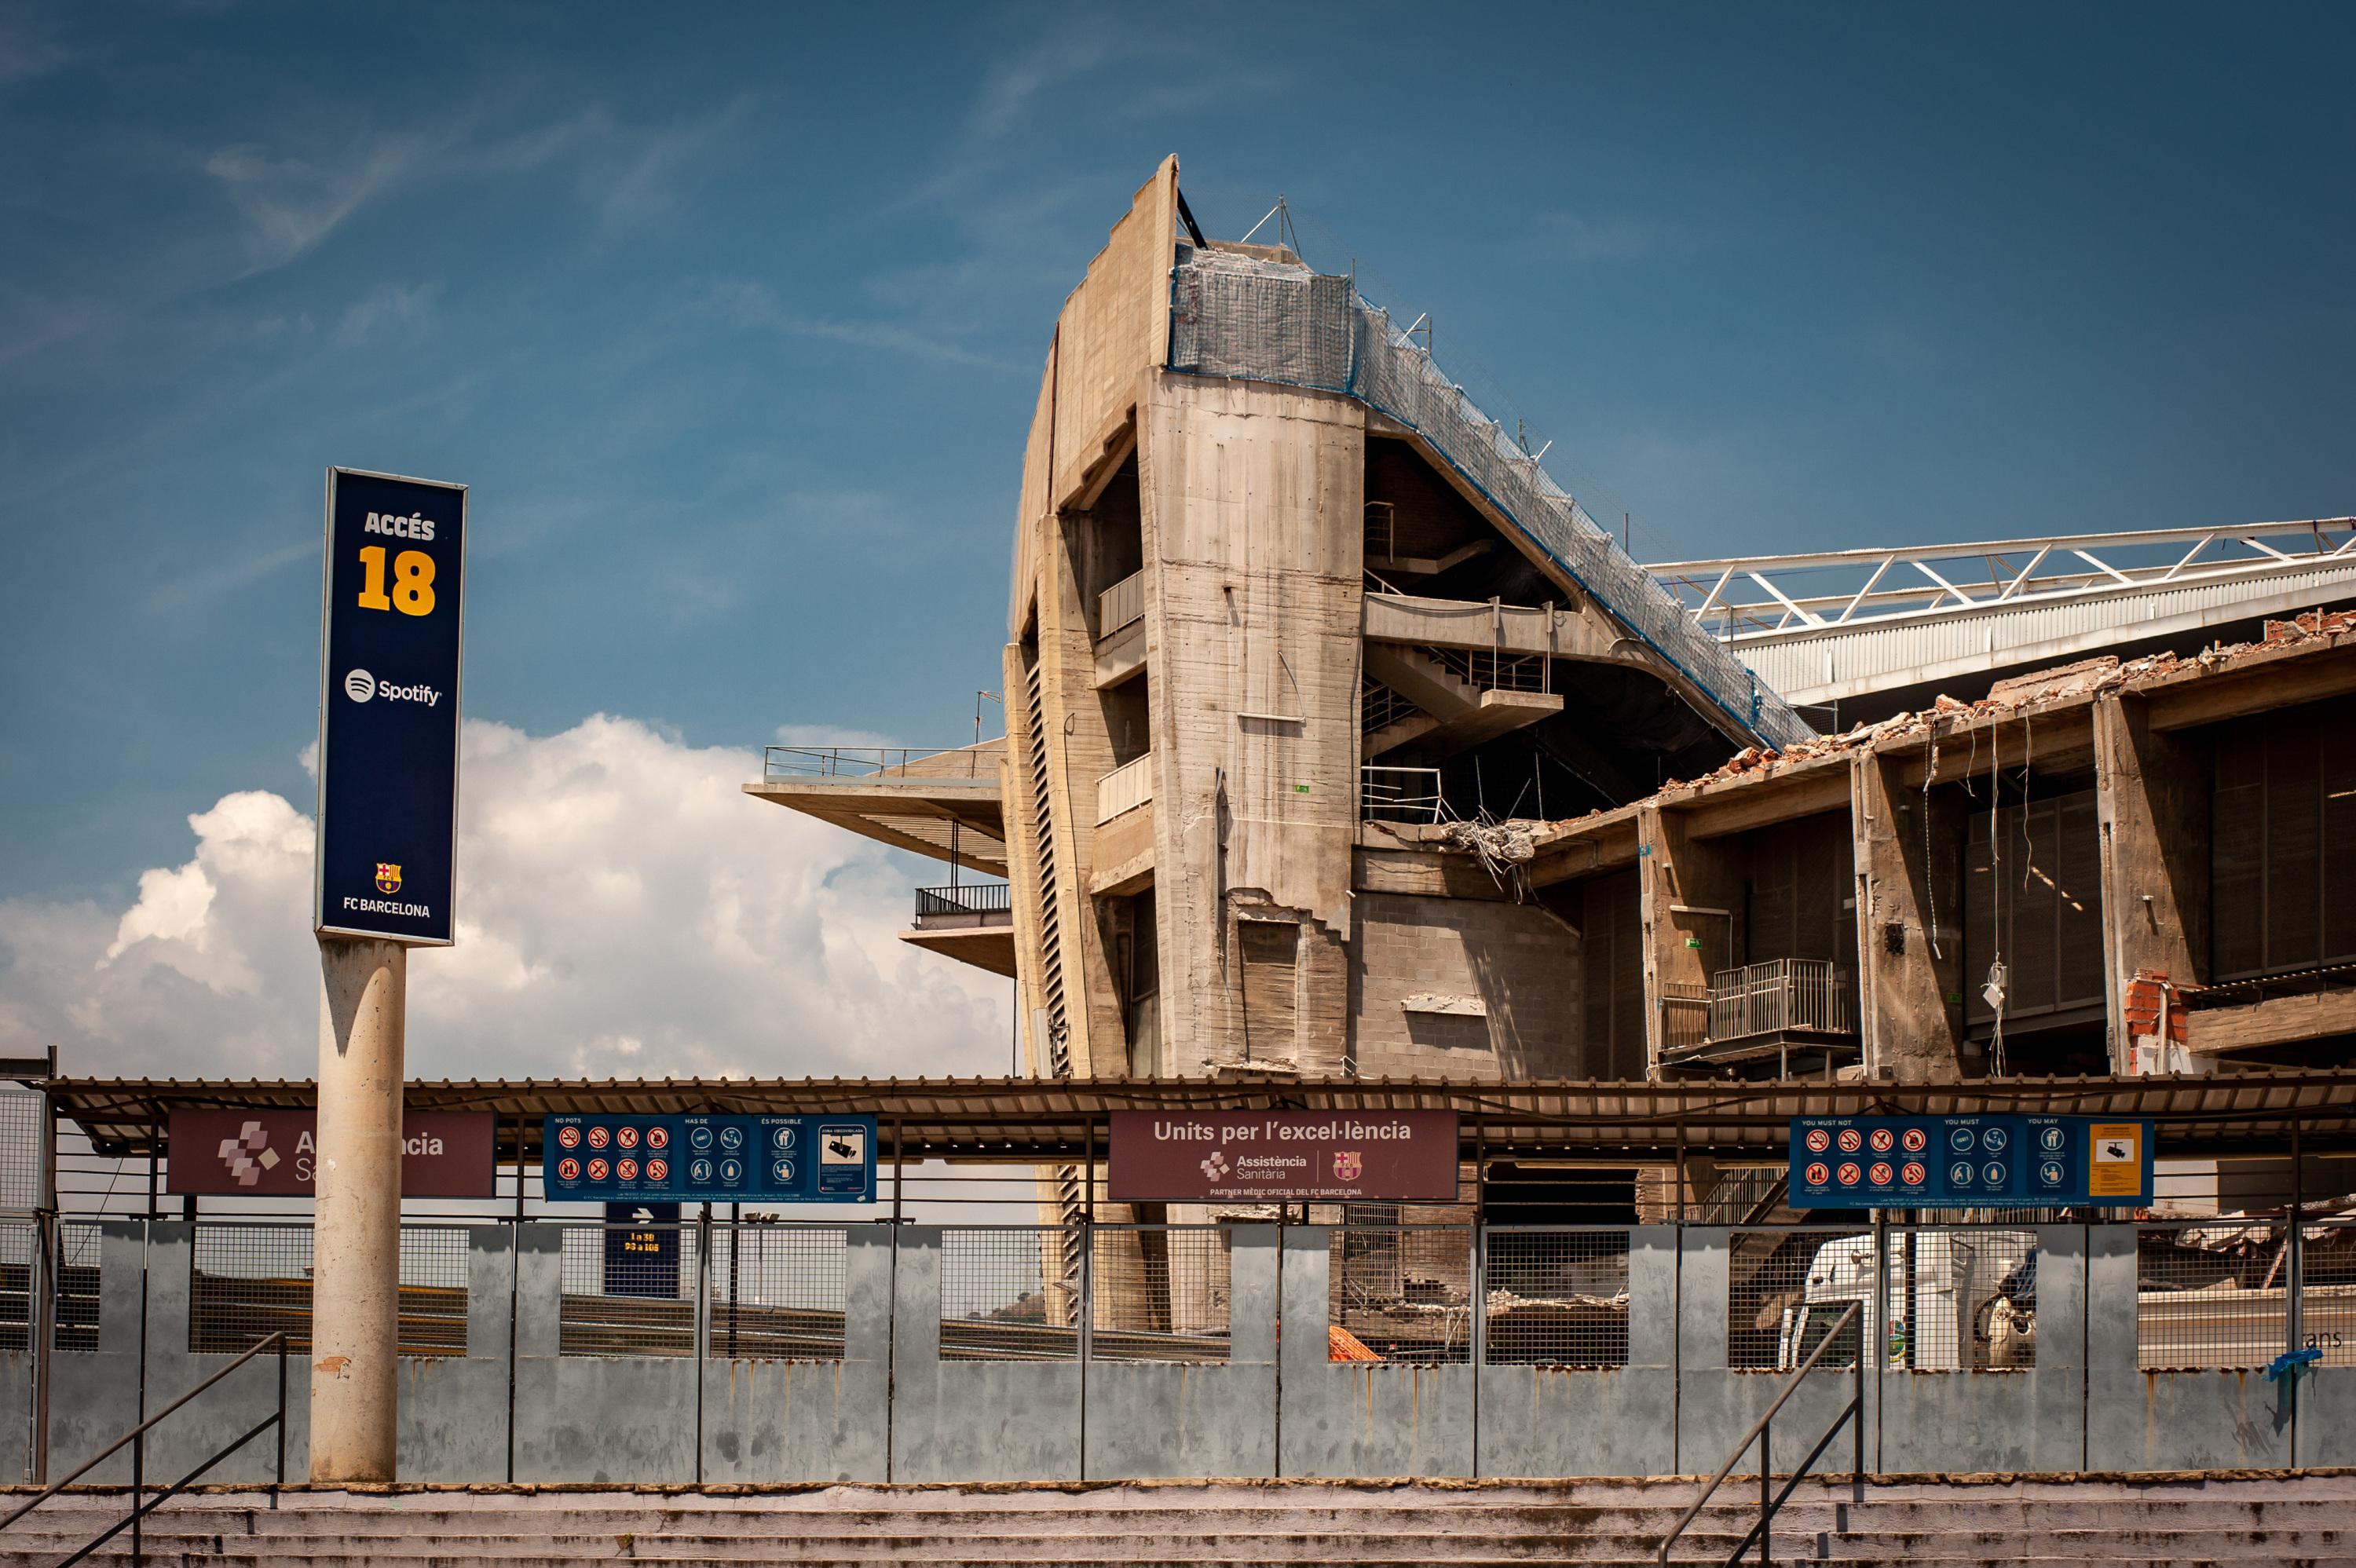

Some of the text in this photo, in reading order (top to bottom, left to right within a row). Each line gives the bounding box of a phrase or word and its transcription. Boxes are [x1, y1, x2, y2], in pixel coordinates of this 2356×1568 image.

[364, 512, 435, 541] ACCÉS
[358, 545, 436, 616] 18
[379, 680, 442, 707] Spotify
[344, 897, 430, 918] FC BARCELONA
[1154, 1121, 1215, 1141] Units
[1222, 1125, 1259, 1145] per
[1236, 1155, 1307, 1168] Assistència
[1236, 1168, 1286, 1180] Sanitària
[1243, 1187, 1266, 1196] MÈDIC
[2303, 1332, 2342, 1348] ans
